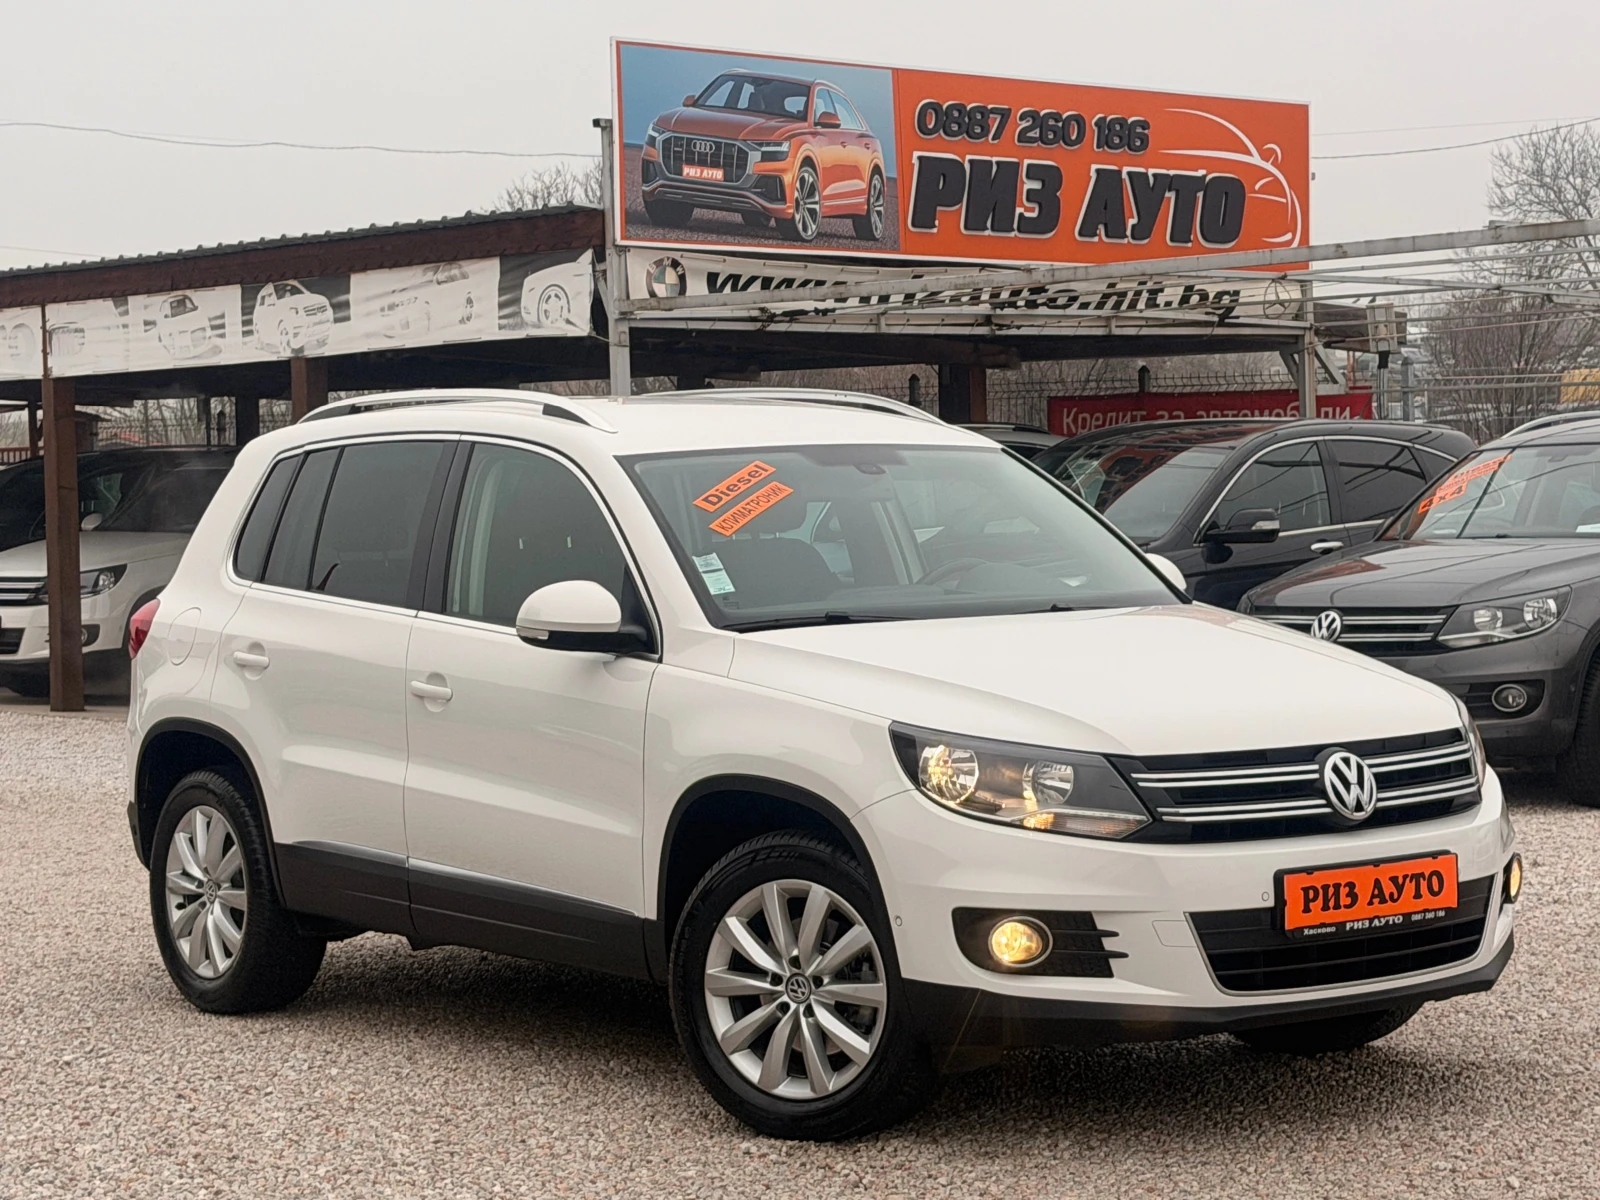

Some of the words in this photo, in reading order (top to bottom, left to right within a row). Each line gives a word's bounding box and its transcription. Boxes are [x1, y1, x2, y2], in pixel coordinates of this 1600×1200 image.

[915, 99, 1012, 143] 0887
[1015, 107, 1087, 149] 260
[1092, 113, 1151, 154] 186
[908, 151, 1063, 238] РИЗ
[1075, 164, 1247, 248] АУТО
[701, 463, 769, 507] Diesel
[715, 483, 788, 532] КЛИМАТРОНИК
[1300, 881, 1359, 914] РИЗ
[1366, 870, 1445, 906] АУТО
[1346, 919, 1370, 931] РИЗ
[1371, 915, 1403, 927] АУТО
